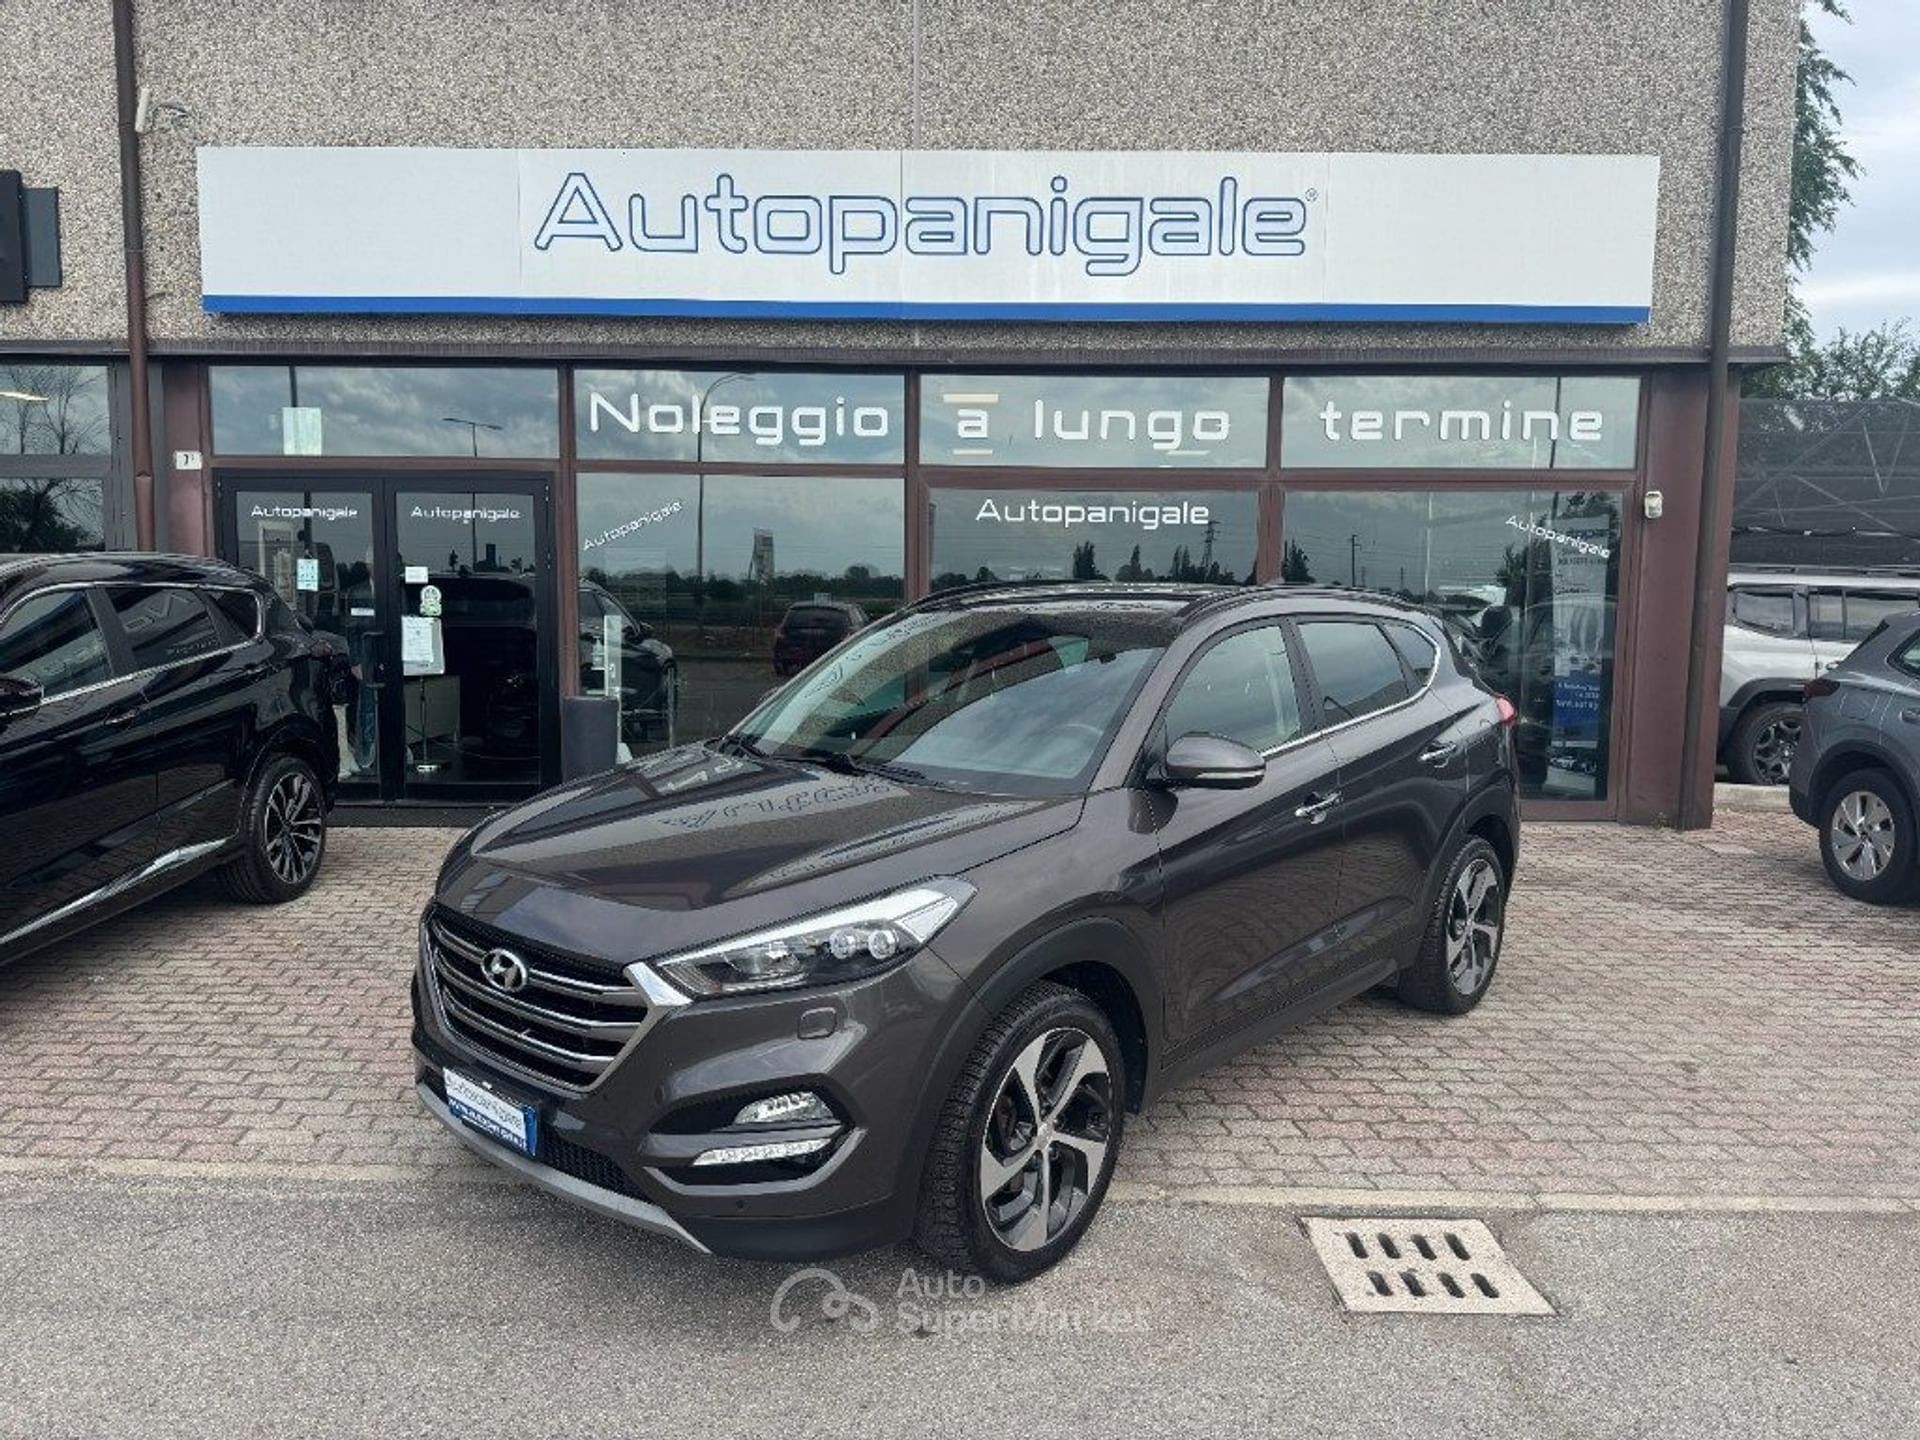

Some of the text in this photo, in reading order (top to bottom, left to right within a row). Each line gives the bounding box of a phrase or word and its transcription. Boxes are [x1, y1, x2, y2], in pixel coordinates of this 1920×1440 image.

[589, 392, 1604, 451] Noleggio a lungo termine
[251, 505, 358, 521] Autopanigale
[411, 506, 521, 522] Autopanigale
[581, 499, 683, 551] Autopanigale
[975, 498, 1210, 531] Autopanigale
[1505, 514, 1611, 558] Autopanigale
